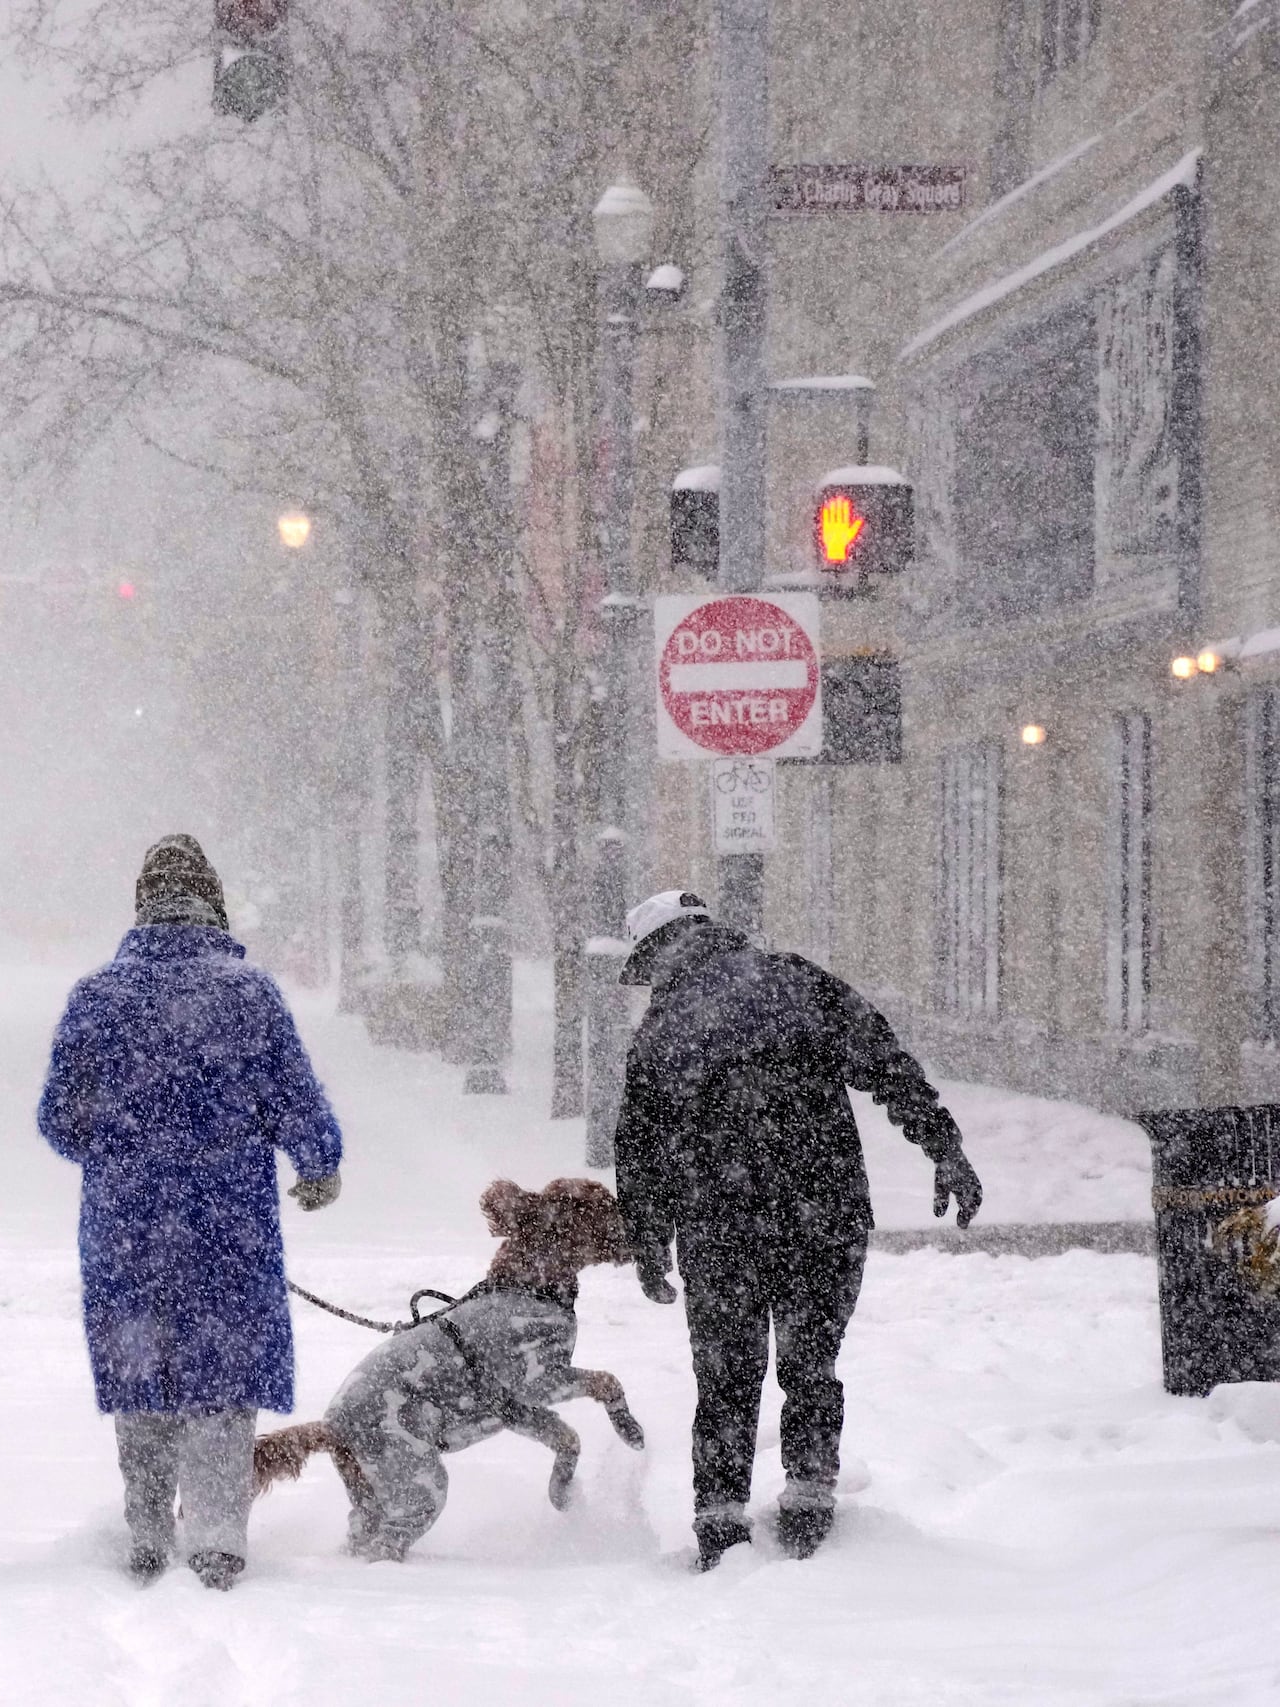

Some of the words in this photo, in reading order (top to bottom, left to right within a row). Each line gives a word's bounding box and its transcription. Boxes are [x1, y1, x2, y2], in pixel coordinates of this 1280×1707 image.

[906, 179, 961, 209] Square
[677, 630, 722, 656] DO
[735, 627, 795, 657] NOT
[690, 697, 789, 725] ENTER
